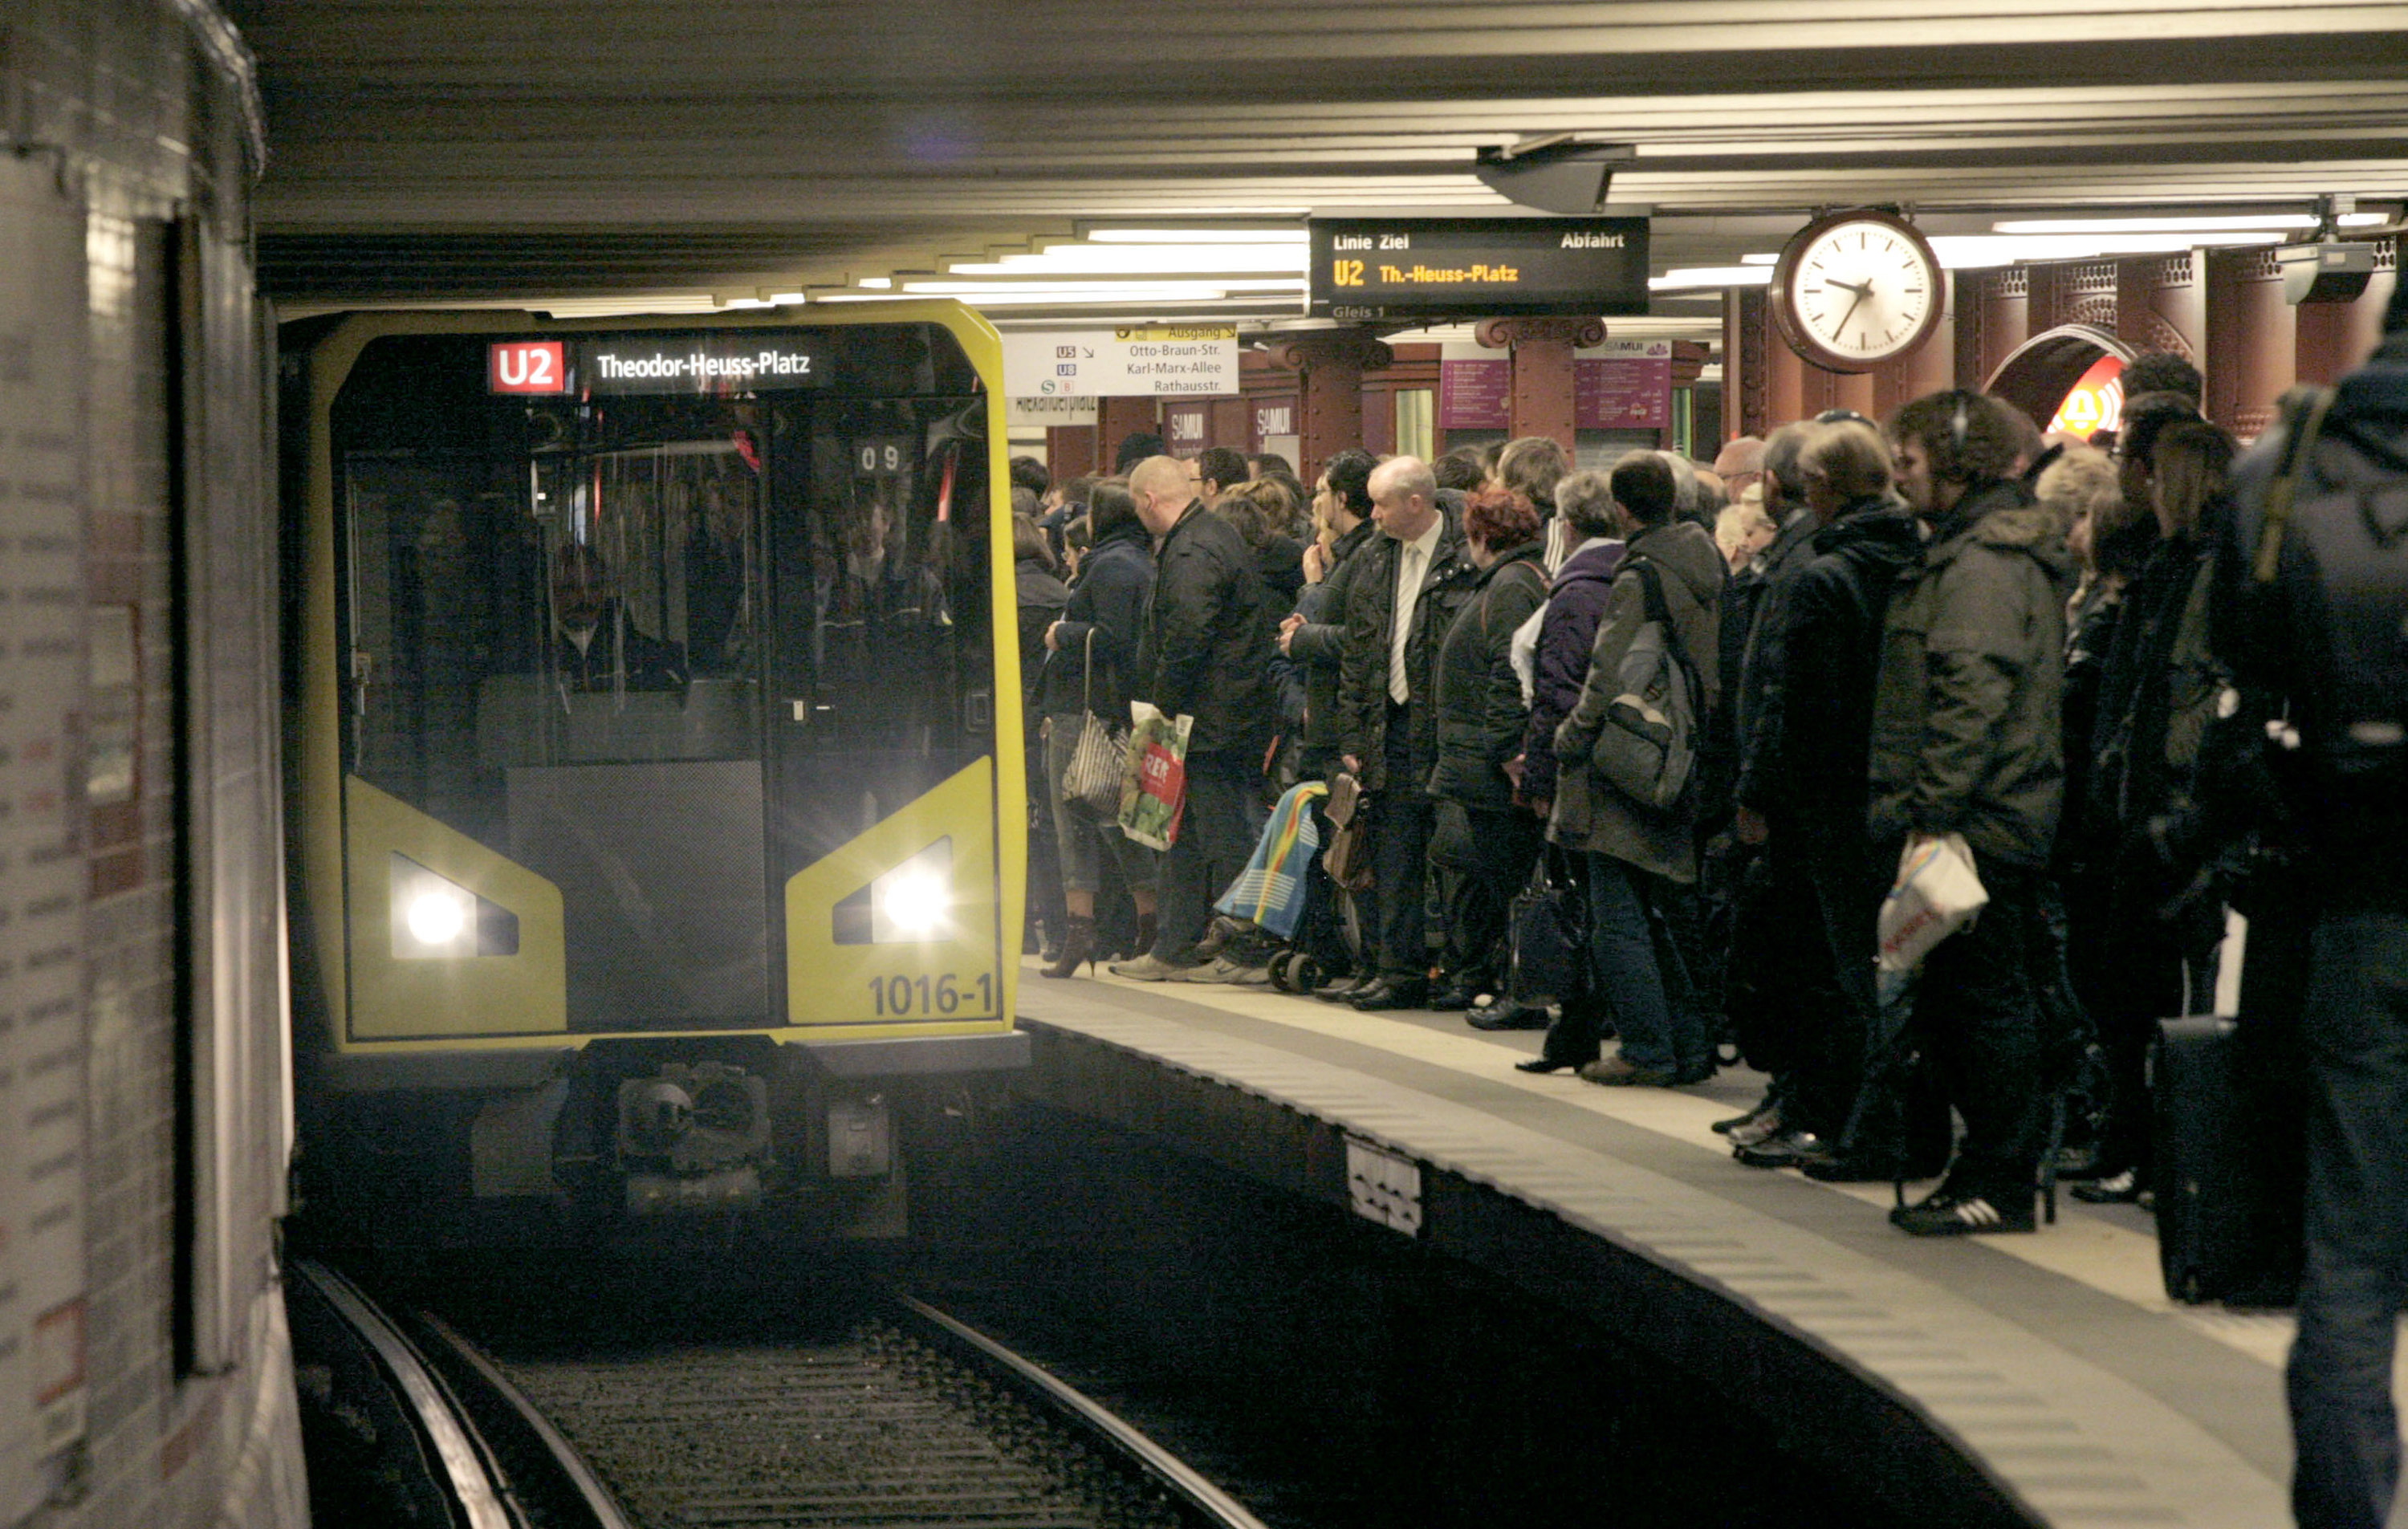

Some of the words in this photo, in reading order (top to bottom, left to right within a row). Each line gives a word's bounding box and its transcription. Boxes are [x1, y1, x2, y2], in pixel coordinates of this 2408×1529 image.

[1333, 235, 1373, 250] Linie
[1379, 234, 1409, 250] Ziel
[1560, 232, 1625, 248] Abfahrt
[1333, 259, 1365, 287] U2
[1379, 264, 1519, 283] Th.-Heuss-Platz
[1332, 306, 1373, 318] Gleis
[1377, 306, 1385, 318] 1
[1168, 327, 1221, 340] Ausgang
[1058, 346, 1076, 358] U5
[1129, 344, 1221, 357] Otto-Braun-Str.
[499, 348, 553, 385] U2
[597, 351, 811, 378] Theodor-Heuss-Platz
[1058, 364, 1076, 376] U8
[1127, 361, 1222, 375] Karl-Marx-Allee
[1154, 380, 1221, 392] Rathausstr.
[1172, 413, 1203, 441] SAMUI
[1257, 407, 1290, 436] SAMUI
[869, 972, 991, 1016] 1016-1
